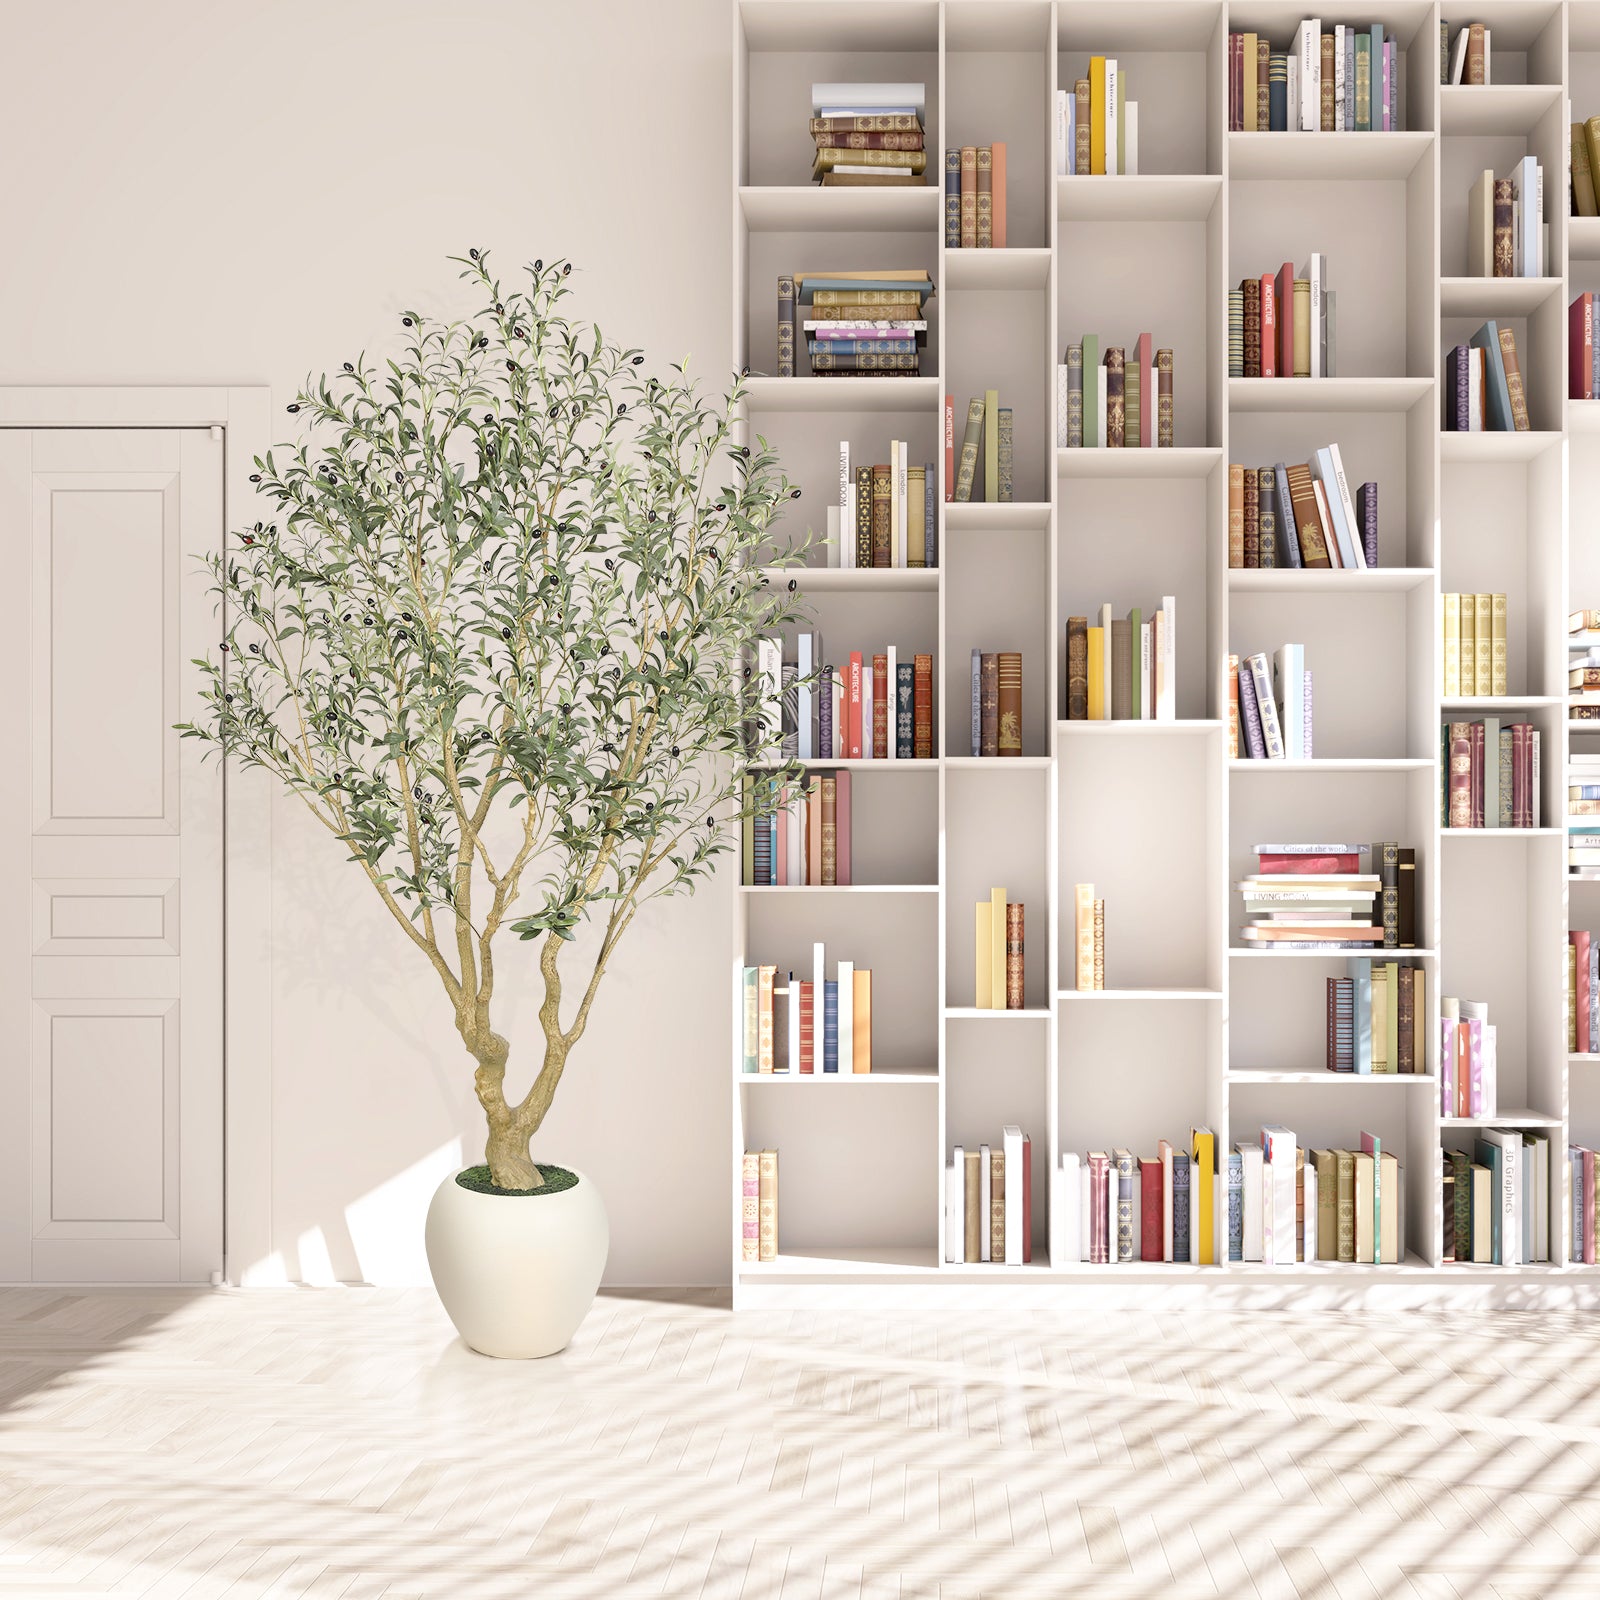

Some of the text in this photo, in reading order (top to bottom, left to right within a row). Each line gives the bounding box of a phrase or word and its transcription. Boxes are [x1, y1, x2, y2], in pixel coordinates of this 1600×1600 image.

[1347, 74, 1354, 82] of
[1337, 471, 1350, 503] bedroom
[926, 487, 934, 507] Cities
[1282, 486, 1291, 507] Cities
[926, 509, 934, 518] of
[926, 519, 934, 531] the
[1286, 519, 1295, 531] the
[926, 532, 934, 553] world
[1289, 532, 1298, 552] world
[973, 673, 981, 694] Cities
[973, 695, 981, 704] of
[973, 705, 981, 717] the
[973, 719, 981, 739] world
[1283, 844, 1303, 853] Cities
[1305, 844, 1314, 853] of
[1315, 844, 1327, 853] the
[1329, 844, 1348, 853] world
[1254, 893, 1281, 901] LIVING
[1591, 987, 1598, 996] of
[1504, 1148, 1513, 1214] 3D Graphics
[1576, 1176, 1584, 1197] Cities
[1576, 1209, 1584, 1220] the
[1576, 1221, 1584, 1241] world
